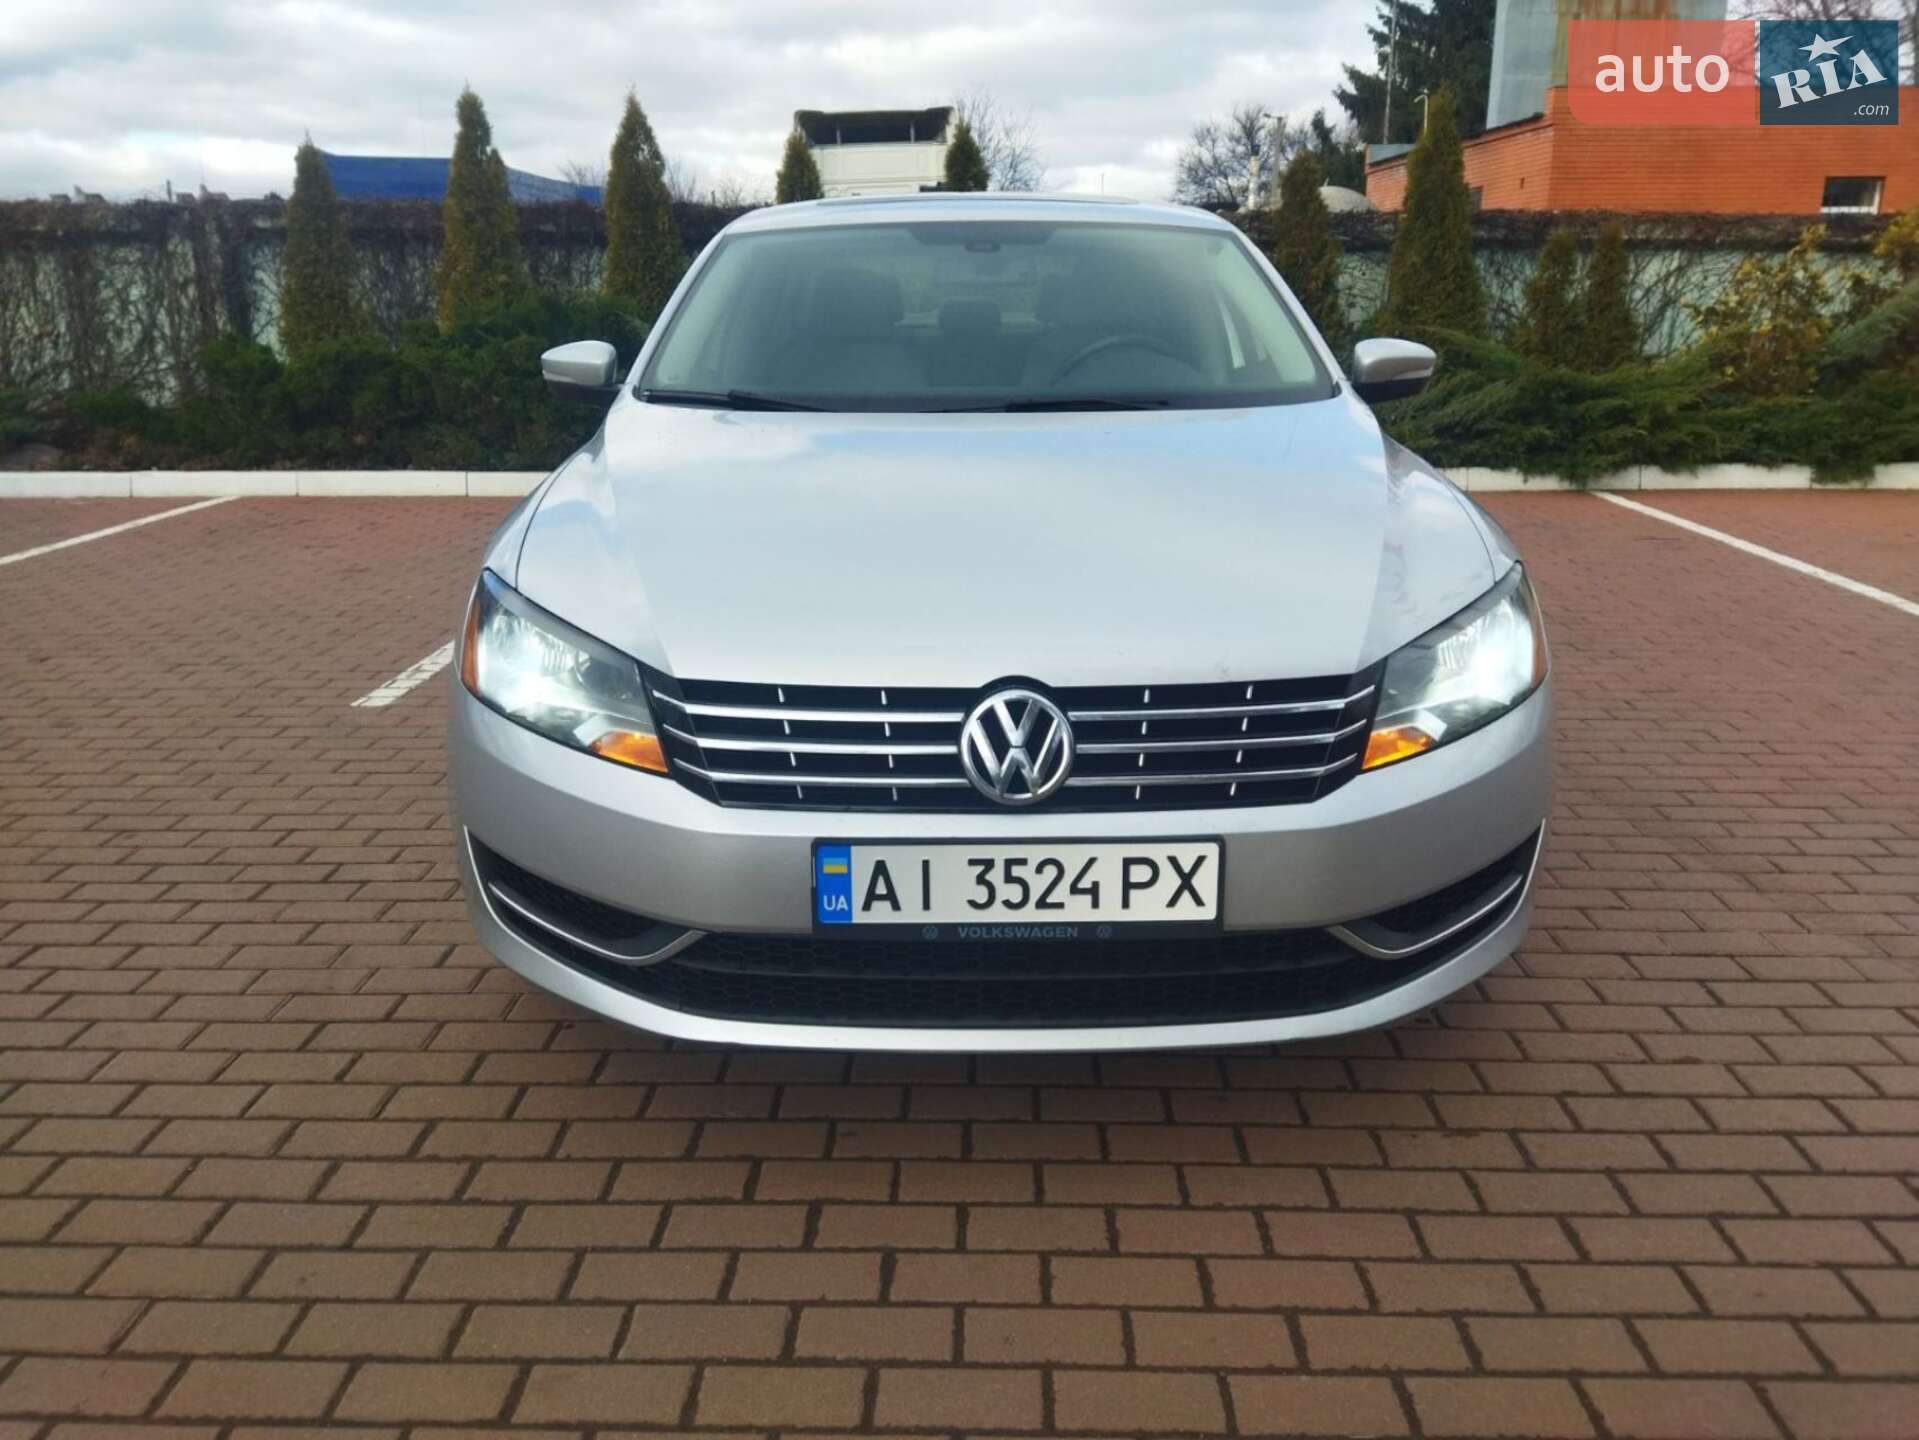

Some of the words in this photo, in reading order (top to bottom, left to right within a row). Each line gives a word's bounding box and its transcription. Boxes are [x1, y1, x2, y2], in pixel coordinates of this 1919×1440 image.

[861, 859, 931, 911] AI
[966, 857, 1101, 911] 3524
[1122, 855, 1207, 909] PX
[823, 894, 849, 912] UA
[957, 926, 1079, 940] VOLKSWAGEN
